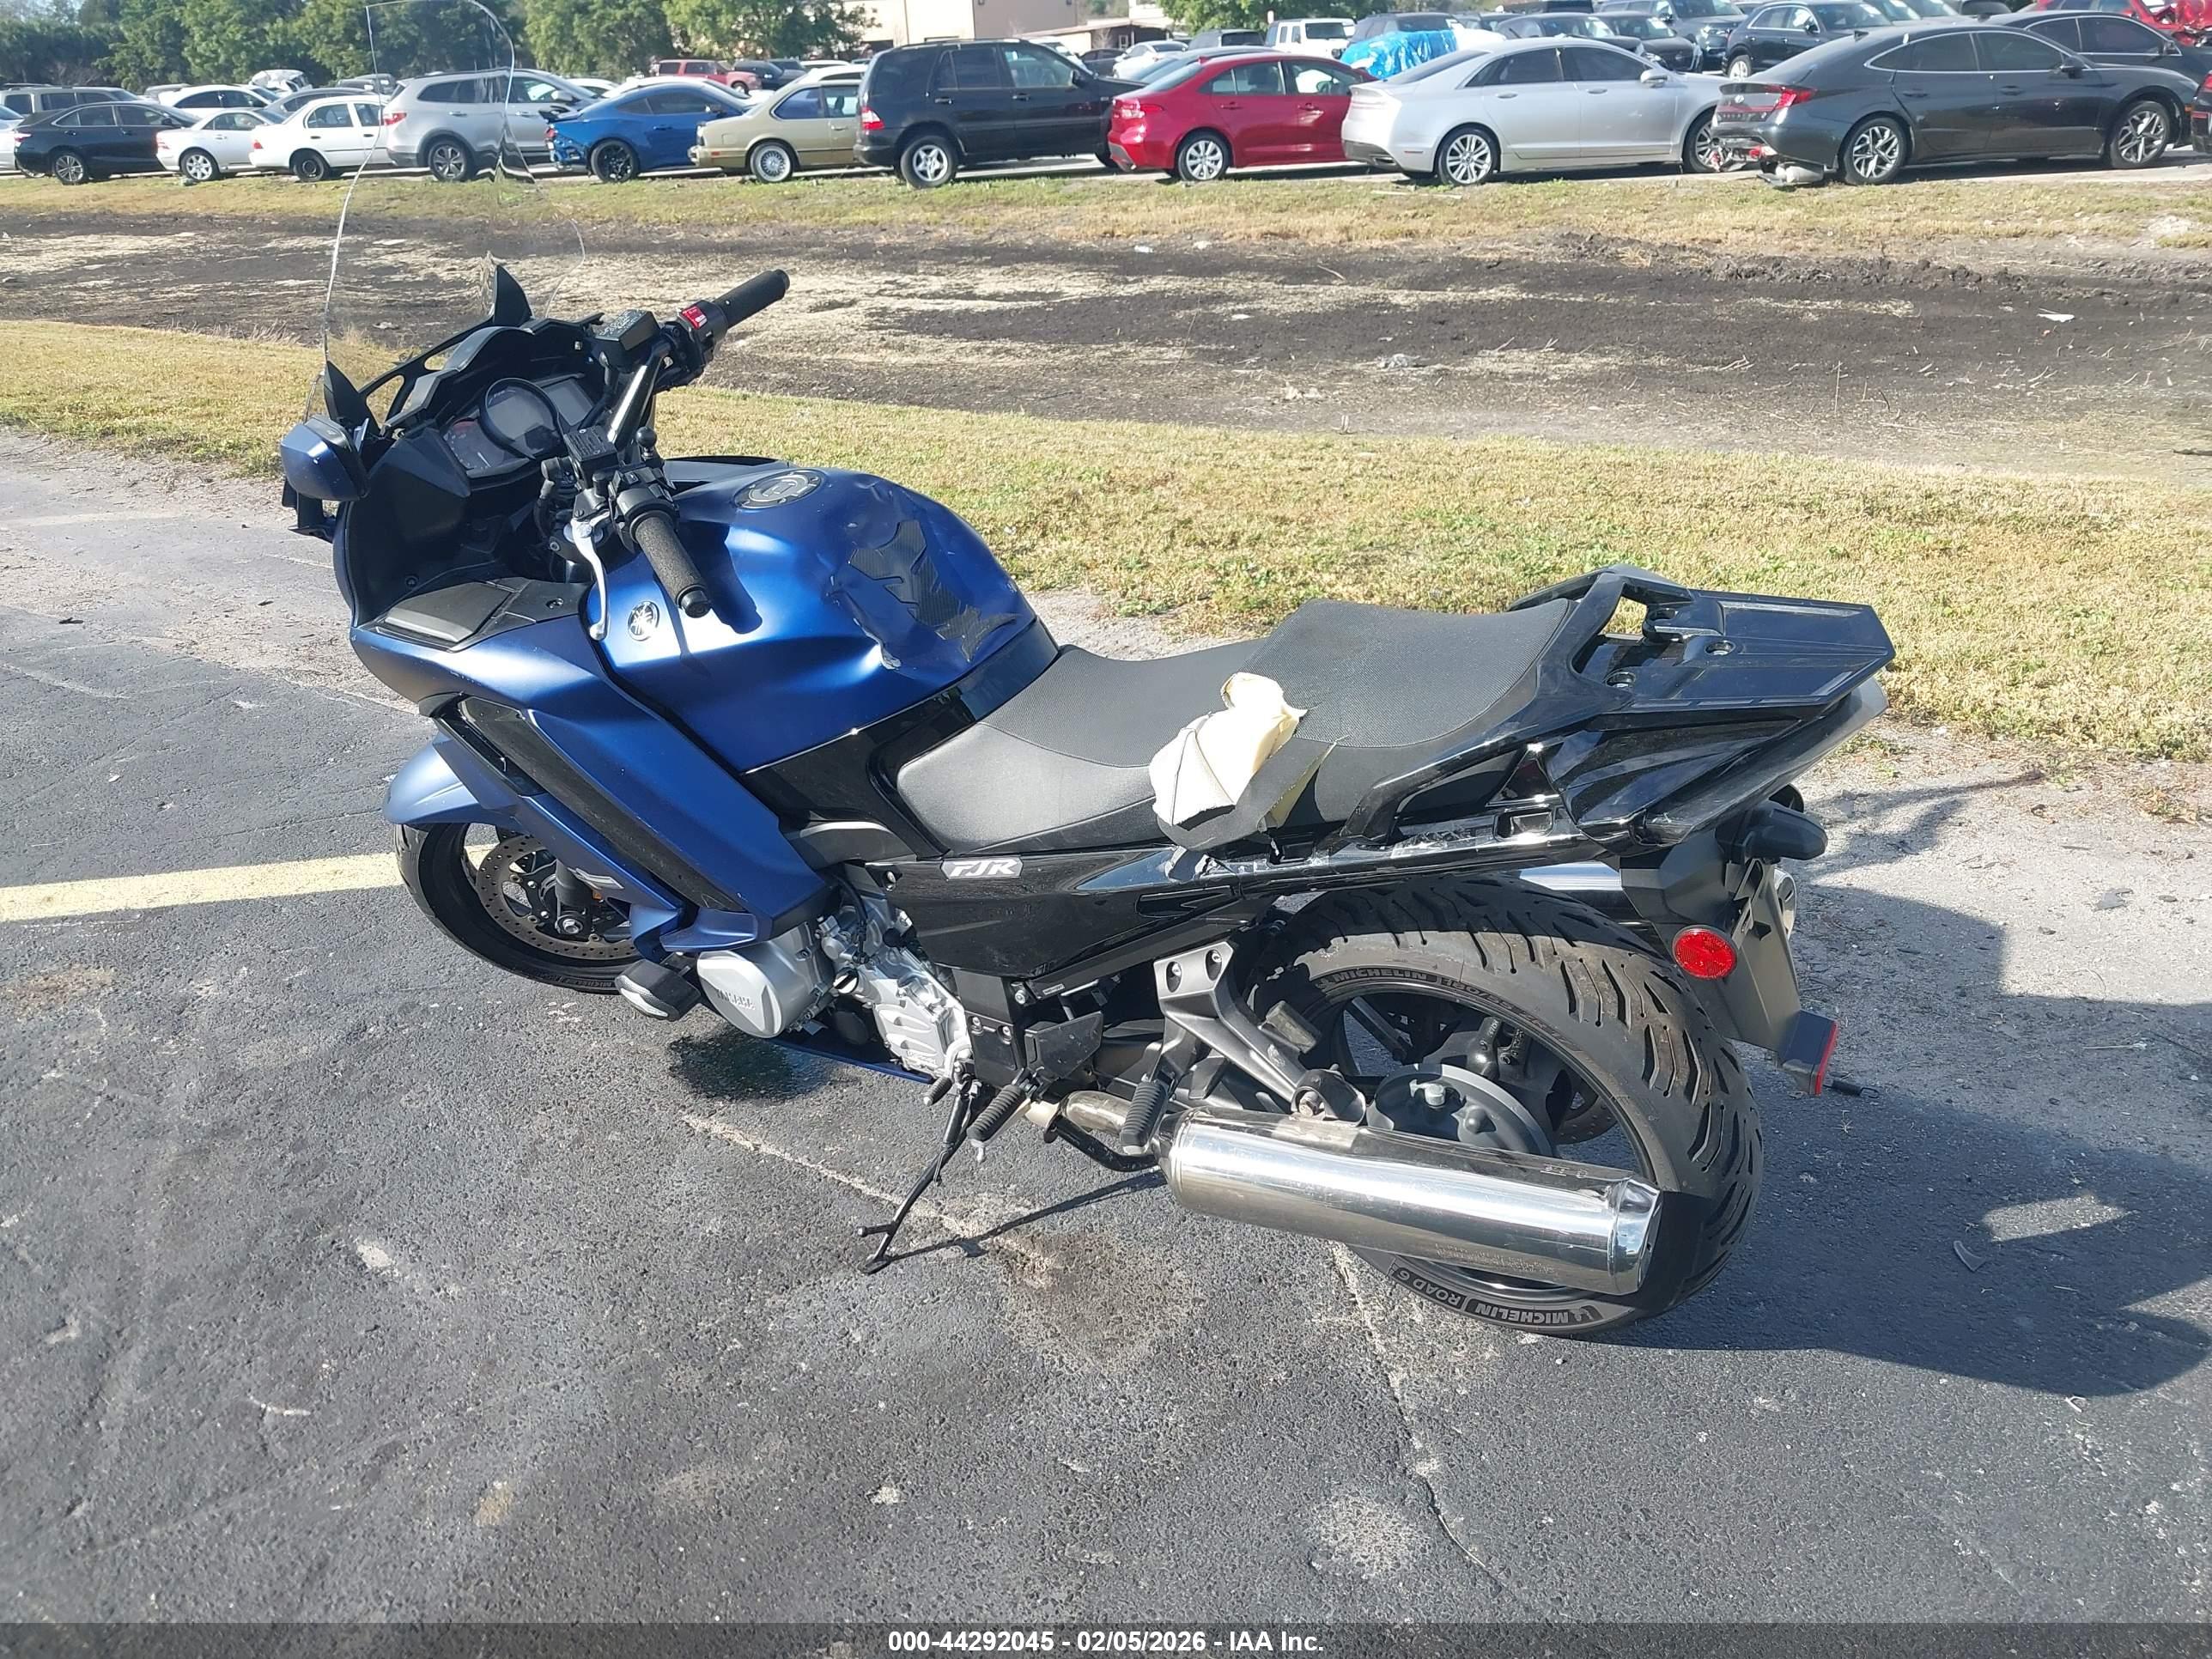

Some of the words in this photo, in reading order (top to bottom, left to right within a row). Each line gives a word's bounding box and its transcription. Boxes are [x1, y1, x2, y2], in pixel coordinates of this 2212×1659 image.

[950, 860, 1018, 877] FJR
[1333, 969, 1428, 982] MICHELIN
[1396, 1269, 1411, 1281] 6
[1412, 1278, 1462, 1305] ROAD
[1474, 1302, 1570, 1324] MICHELIN
